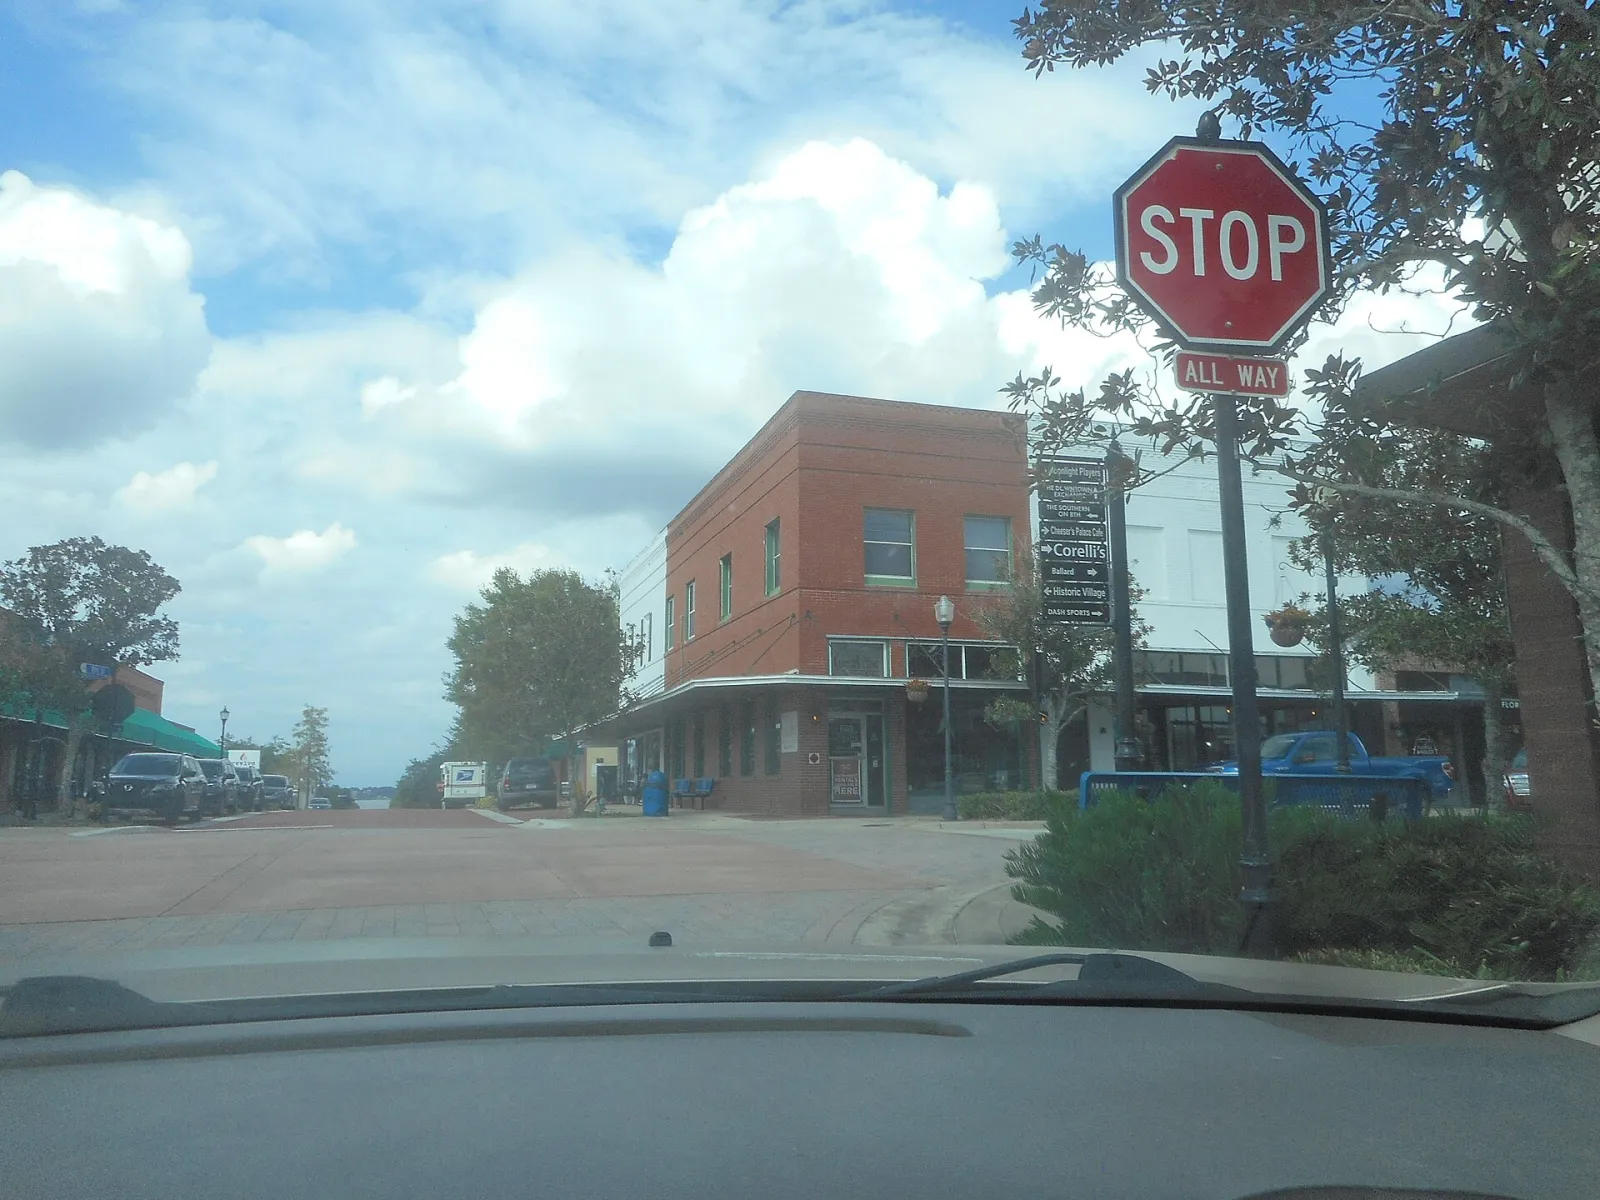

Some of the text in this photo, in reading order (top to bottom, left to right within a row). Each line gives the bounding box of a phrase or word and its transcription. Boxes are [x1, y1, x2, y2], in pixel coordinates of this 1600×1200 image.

[1140, 204, 1306, 281] STOP
[1185, 360, 1279, 389] ALL WAY
[1079, 467, 1101, 479] Players
[1053, 543, 1106, 559] Corelli's
[1051, 567, 1075, 576] Ballard
[1053, 586, 1106, 599] Historic Village
[1047, 608, 1091, 617] DASH SPORTS
[834, 787, 859, 795] HERE
